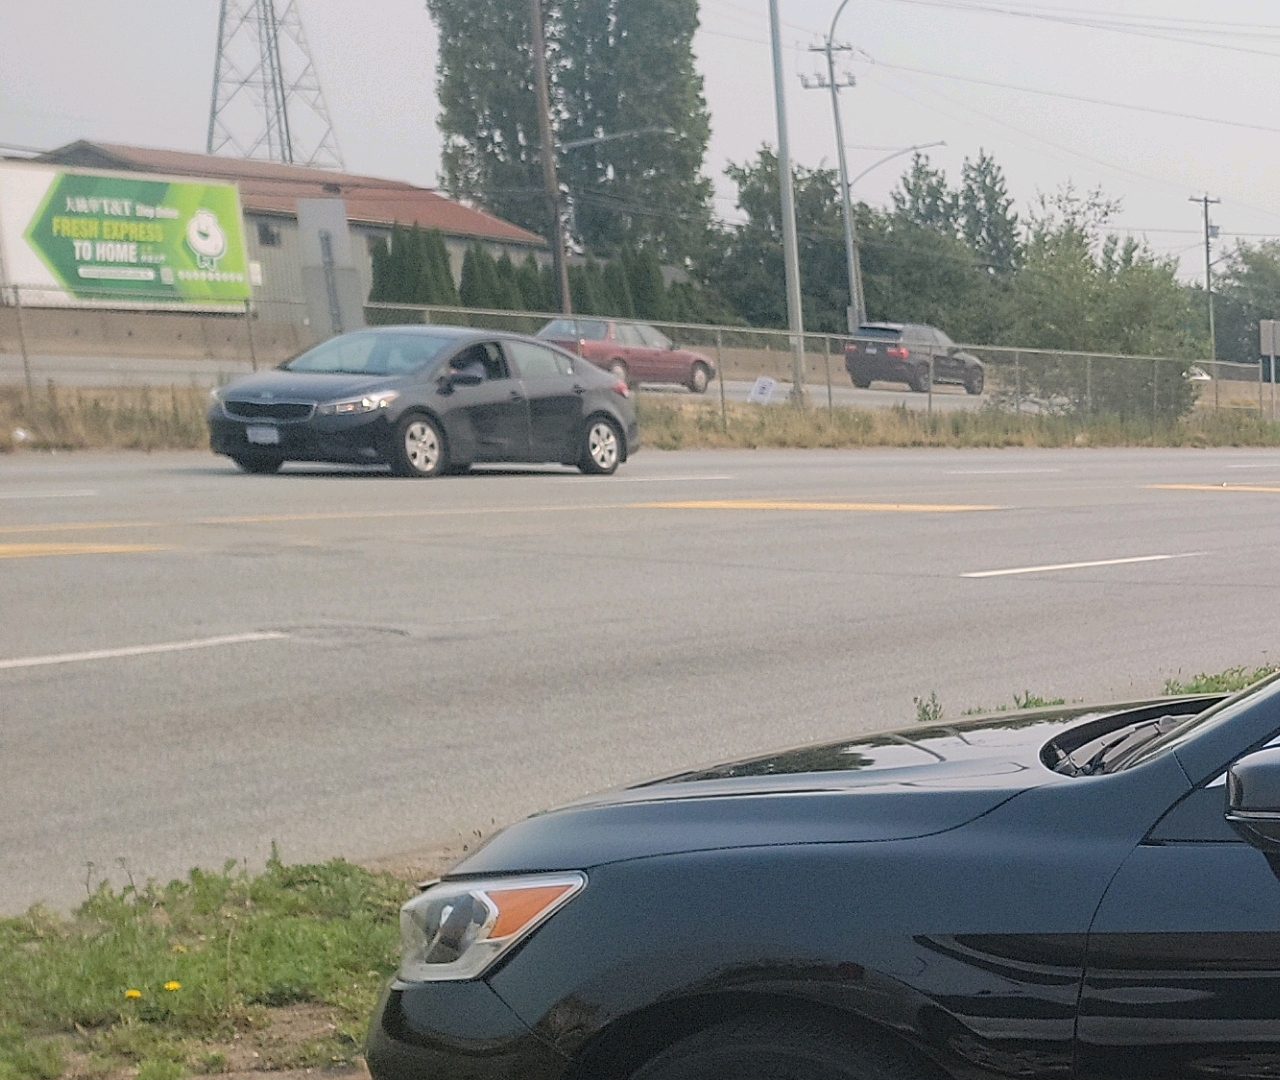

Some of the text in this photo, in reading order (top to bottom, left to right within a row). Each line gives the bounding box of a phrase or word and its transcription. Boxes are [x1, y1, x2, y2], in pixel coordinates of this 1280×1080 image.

[52, 216, 164, 242] FRESH EXPRESS
[73, 240, 92, 261] TO
[95, 241, 137, 263] HOME
